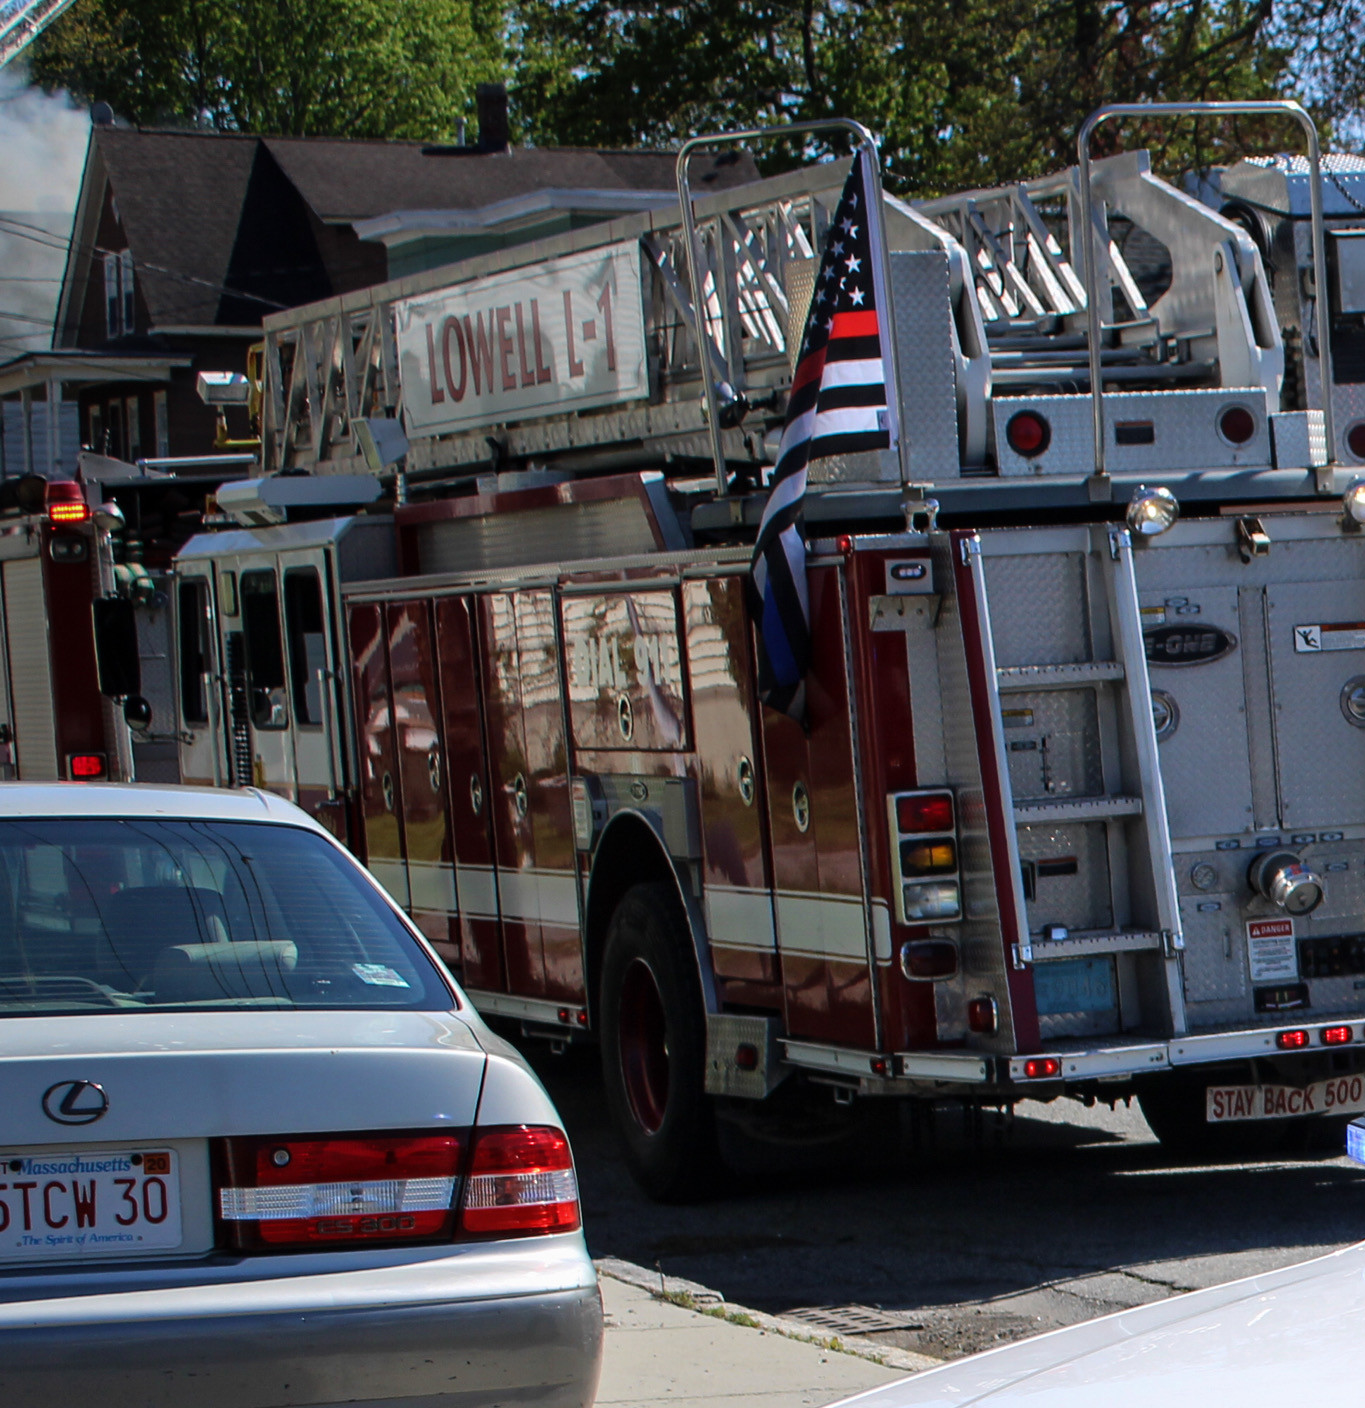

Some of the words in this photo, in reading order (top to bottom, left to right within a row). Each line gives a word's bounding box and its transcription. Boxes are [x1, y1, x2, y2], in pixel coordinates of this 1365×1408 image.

[425, 297, 552, 405] LOWELL
[562, 281, 617, 379] L-1
[1261, 923, 1290, 935] DANGER
[1212, 1089, 1256, 1119] STAY
[1263, 1085, 1315, 1115] BACK
[1324, 1077, 1363, 1107] 500
[18, 1157, 131, 1176] Massachusetts
[147, 1157, 167, 1171] 20
[113, 1177, 168, 1226] 30
[360, 1215, 415, 1232] 300
[22, 1235, 43, 1246] The
[45, 1234, 74, 1247] Spirit
[76, 1233, 87, 1245] of
[90, 1232, 133, 1243] America
